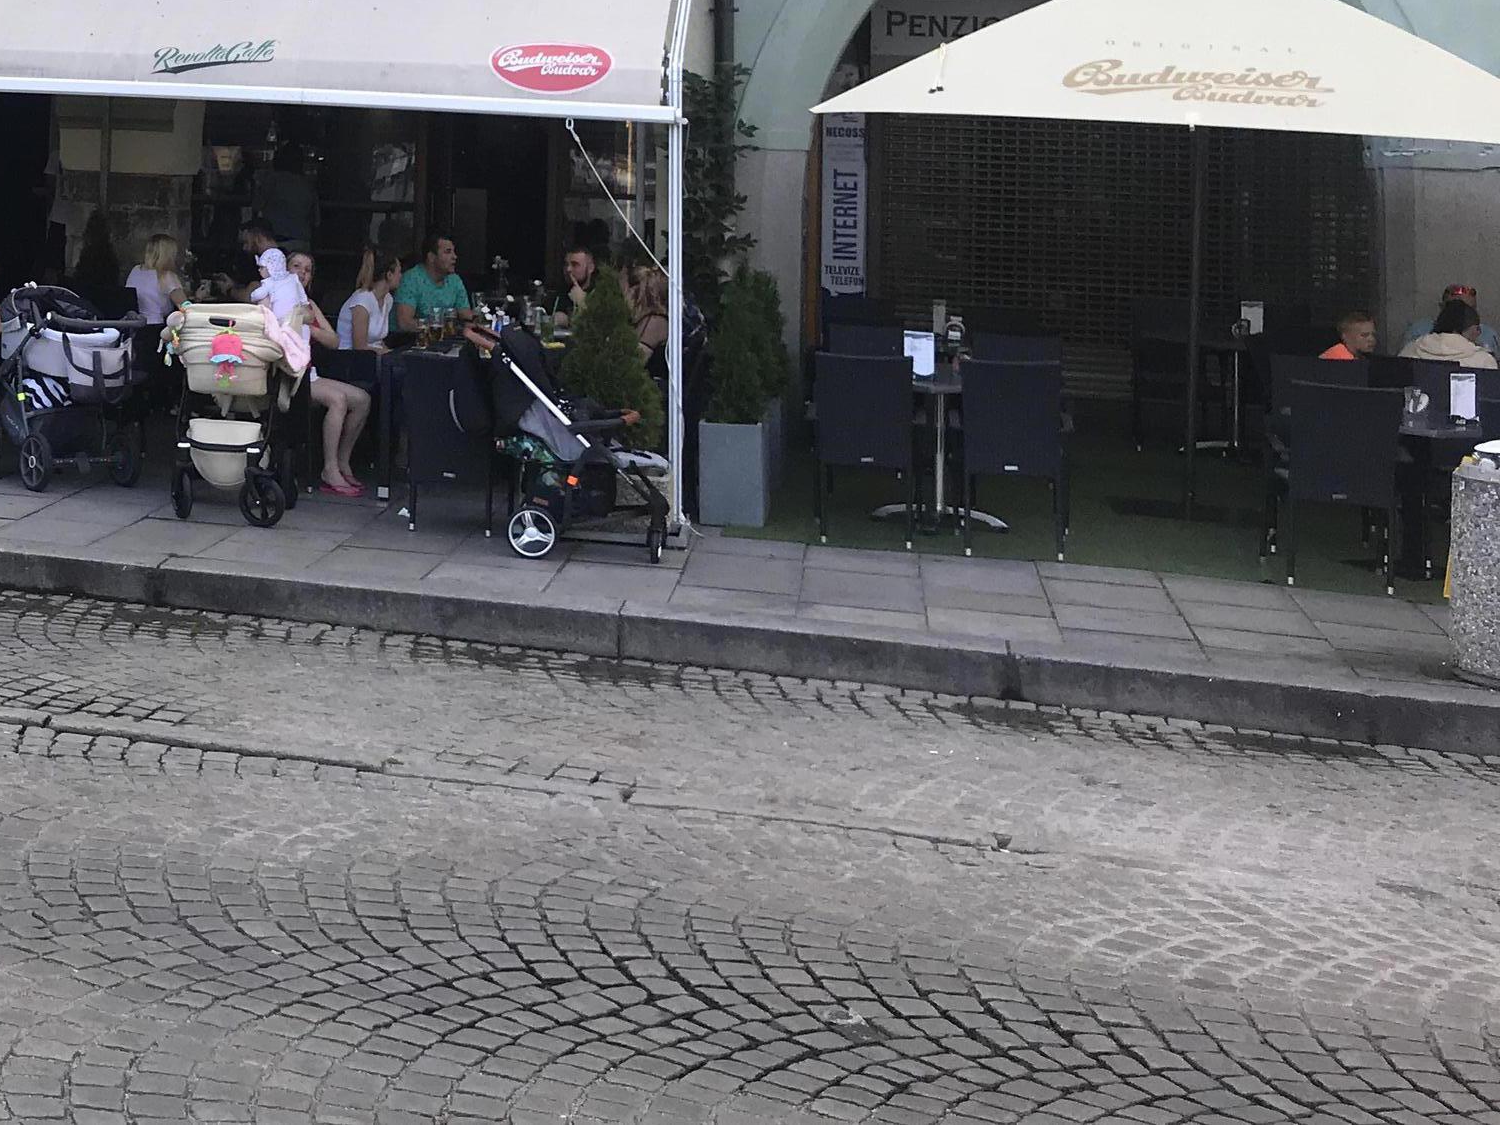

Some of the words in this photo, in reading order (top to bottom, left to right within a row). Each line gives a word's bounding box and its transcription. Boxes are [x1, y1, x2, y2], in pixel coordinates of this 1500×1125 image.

[497, 49, 603, 71] Budweiser
[540, 63, 599, 77] Budvar
[1062, 59, 1334, 94] Budweiser
[1172, 84, 1324, 107] Budvar
[832, 169, 858, 260] INTERNET
